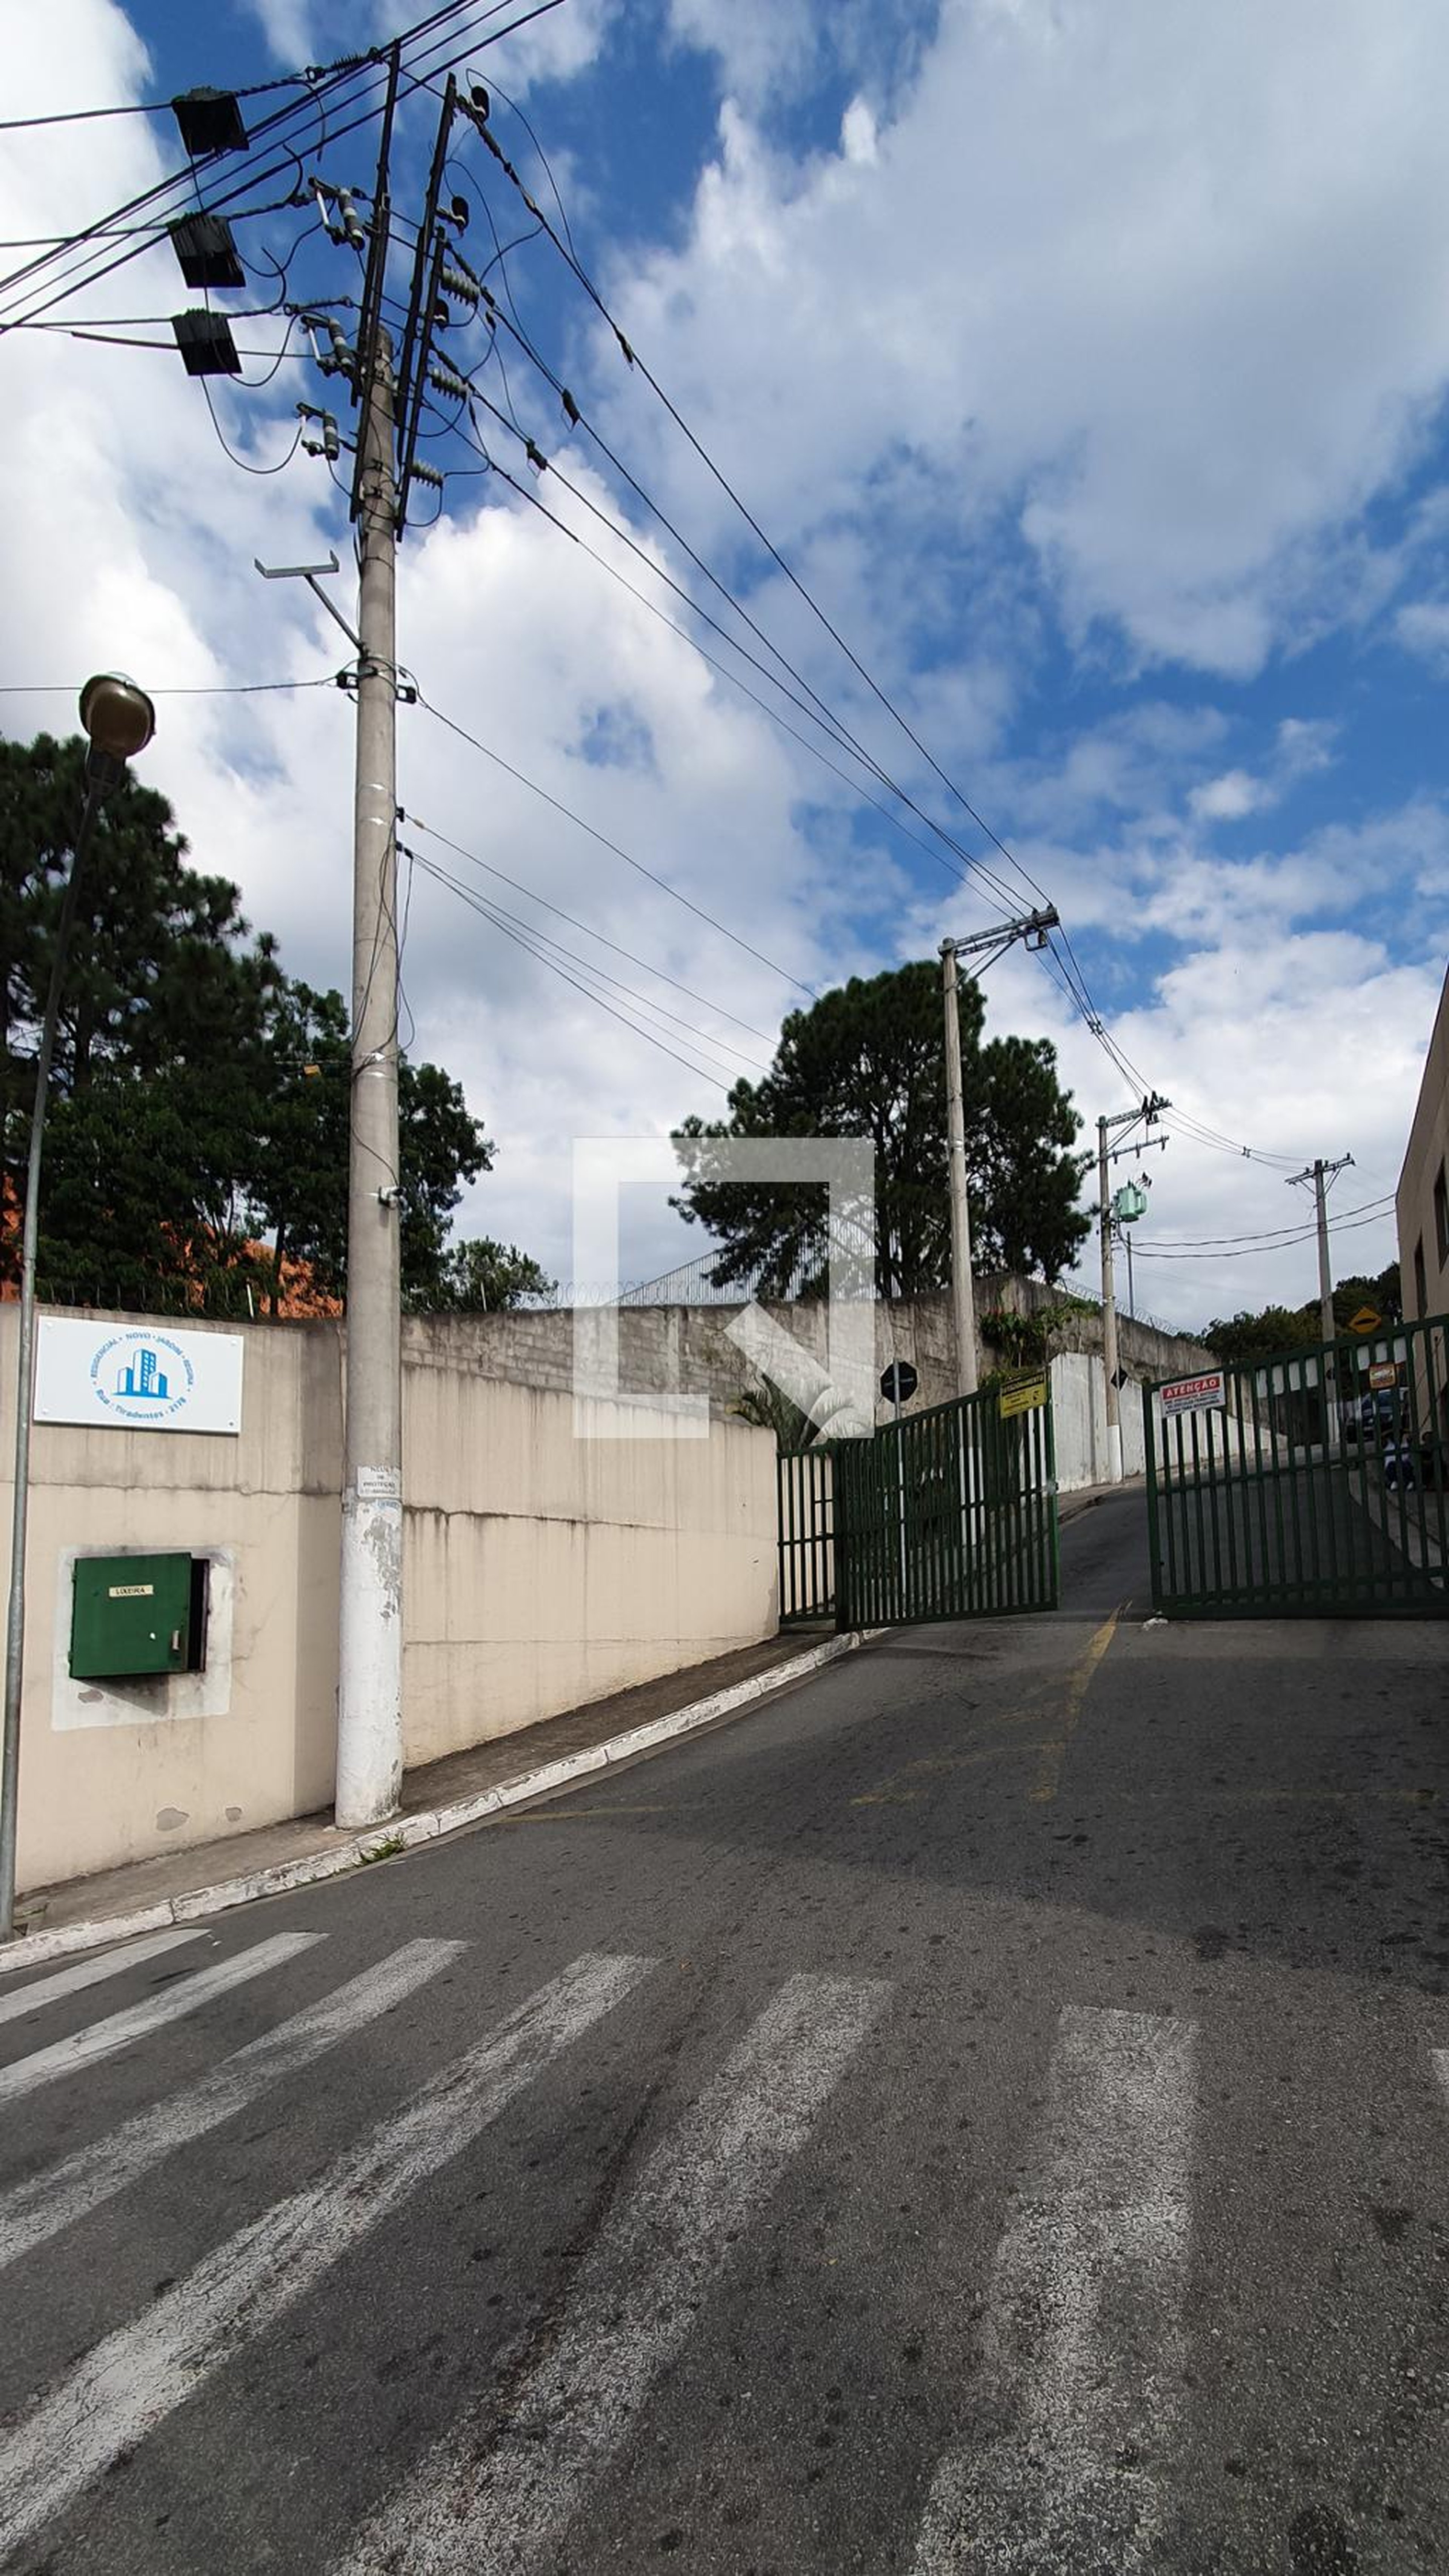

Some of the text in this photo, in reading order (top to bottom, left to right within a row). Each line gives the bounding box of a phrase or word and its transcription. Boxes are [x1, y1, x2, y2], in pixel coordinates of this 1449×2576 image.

[1167, 1379, 1217, 1397] ATENÇÃO
[95, 1389, 110, 1404] Rua
[115, 1405, 164, 1418] Tiradentes
